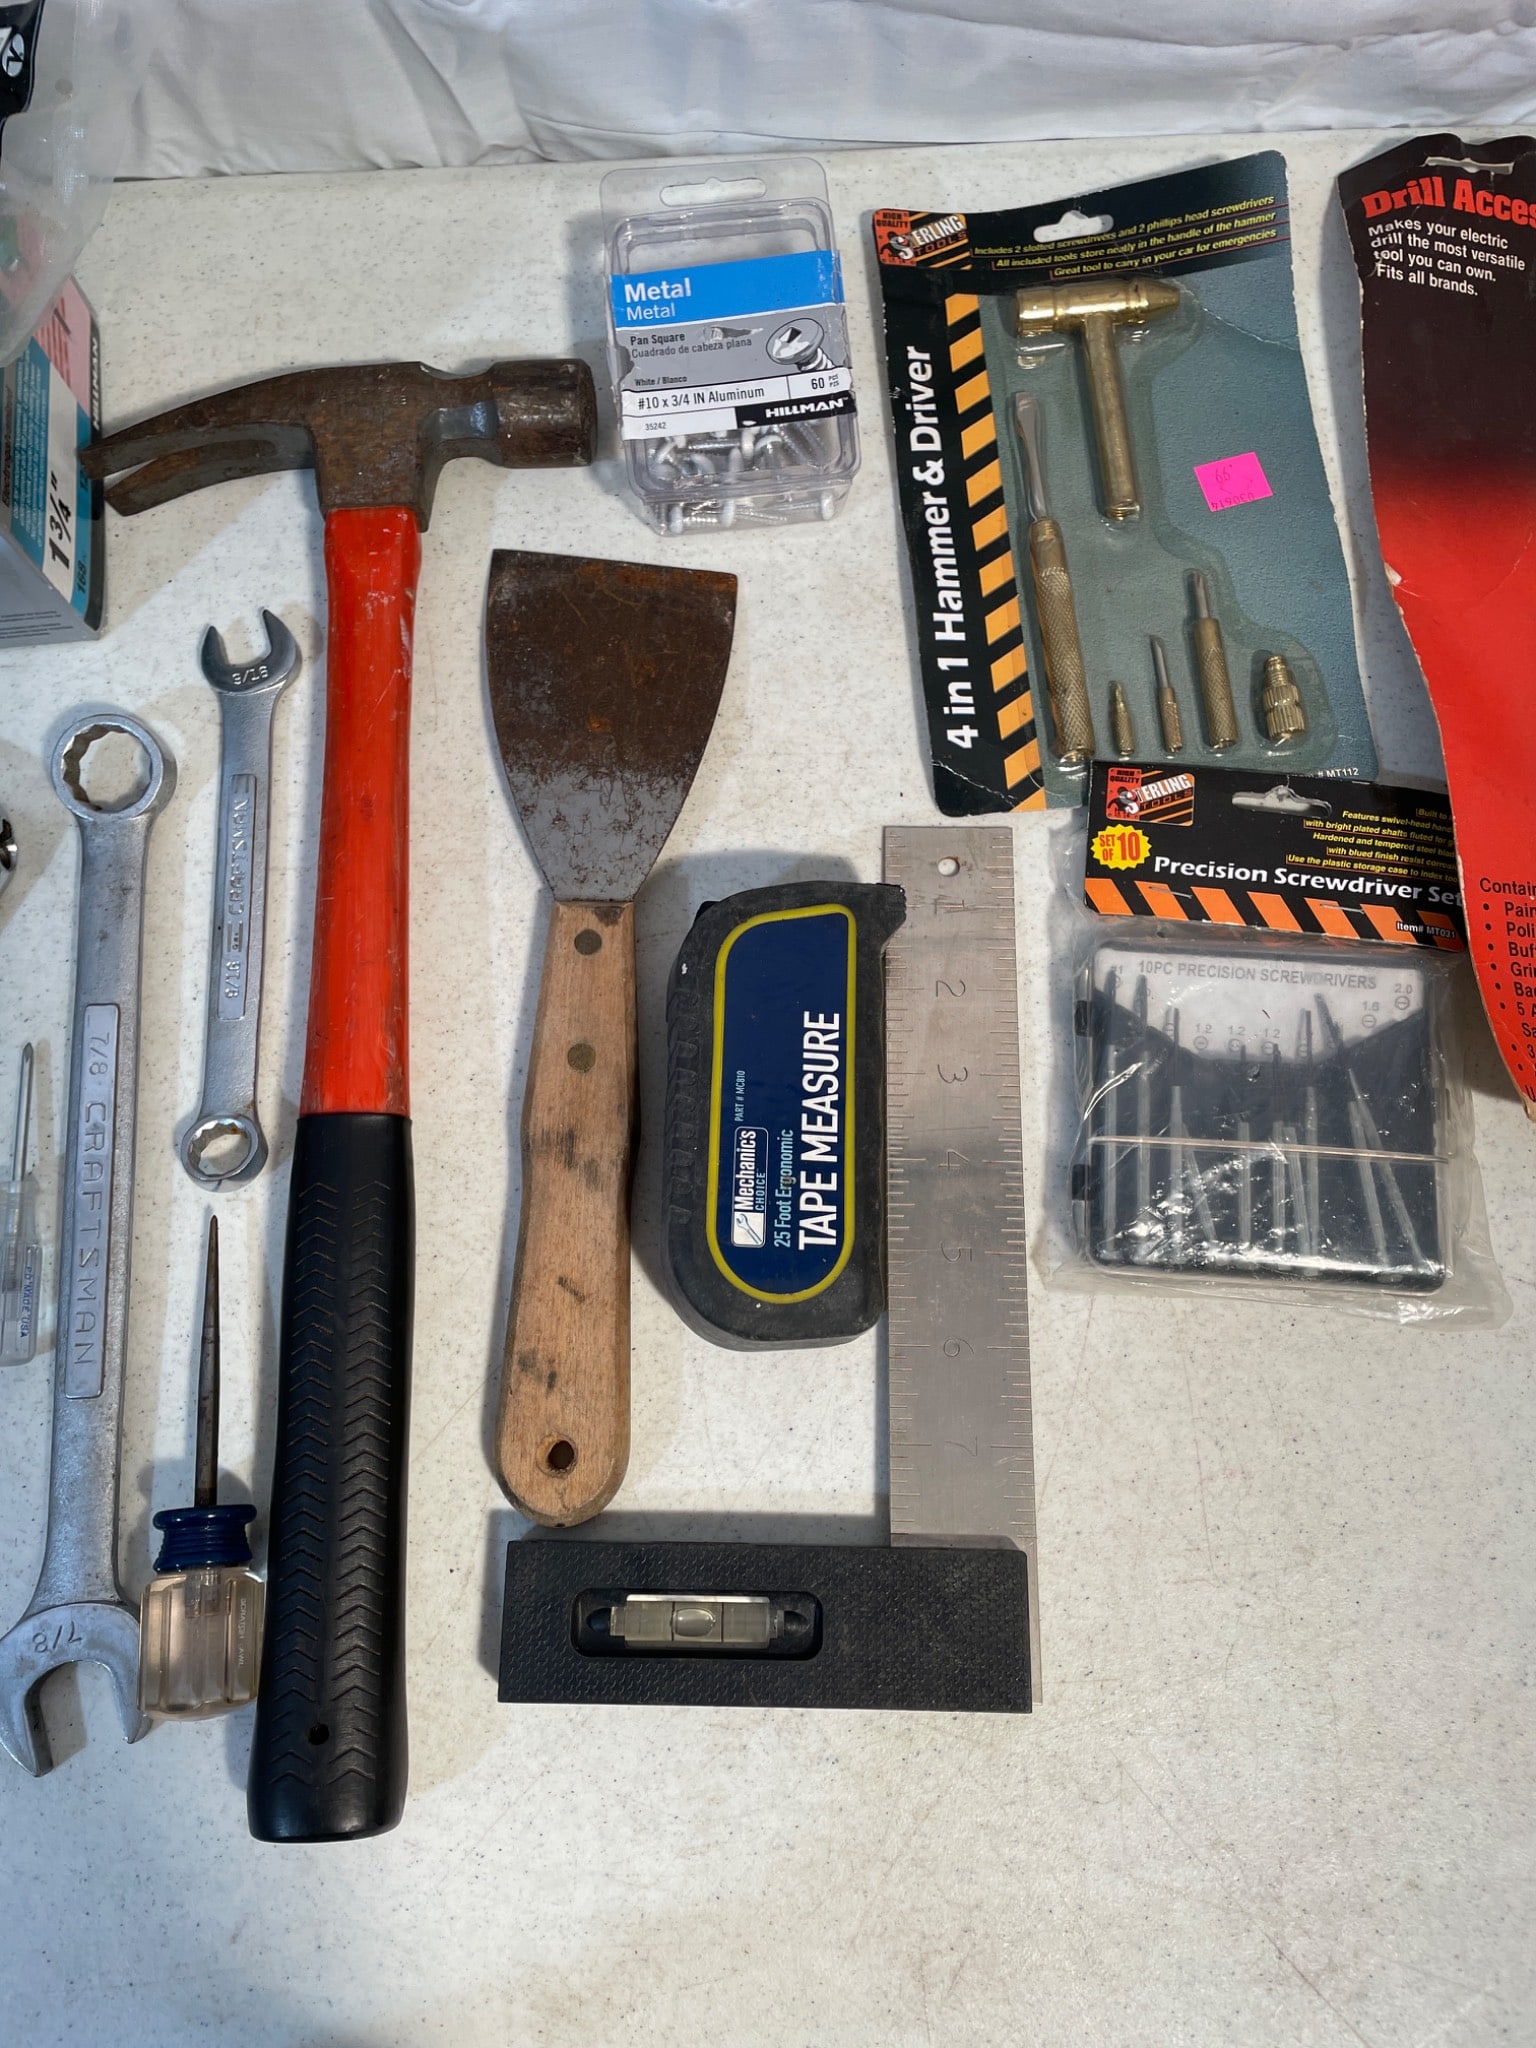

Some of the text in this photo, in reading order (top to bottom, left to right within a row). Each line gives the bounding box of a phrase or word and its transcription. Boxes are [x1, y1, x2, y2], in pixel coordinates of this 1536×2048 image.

[1361, 176, 1446, 218] Drill
[876, 219, 908, 228] QUALITY
[974, 246, 1013, 255] Includes
[1022, 242, 1055, 253] slotted
[1118, 226, 1137, 237] and
[1138, 223, 1145, 232] 2
[1146, 216, 1183, 233] phillips
[1184, 209, 1209, 223] head
[1211, 195, 1275, 216] screwdrivers
[1368, 218, 1509, 249] Makes your electric
[912, 231, 967, 256] TOOLS
[996, 212, 1276, 267] All included tools store neatly in the handle of the hammer
[1370, 232, 1526, 270] drill the most versatile
[1054, 228, 1277, 276] Great tool to carry in your car for emergencies
[1373, 249, 1497, 282] tool you can own.
[624, 278, 692, 303] Metal
[1376, 264, 1478, 296] Fits all brands.
[626, 303, 676, 321] Metal
[630, 332, 685, 346] Pan Square
[632, 338, 752, 359] Cuadrado de cabeza plana
[635, 375, 688, 387] White Blanco
[811, 379, 825, 390] 60
[638, 386, 765, 410] #10 x 3/4 IN Aluminum
[765, 398, 844, 418] HILLMAN
[645, 422, 667, 431] 35242
[49, 538, 69, 569] 1
[905, 345, 978, 749] 4 in 1 Hammer & Driver
[1109, 776, 1139, 784] QUALITY
[1326, 767, 1360, 778] MT112
[1141, 789, 1192, 810] TOOLS
[1306, 819, 1324, 828] with
[1325, 820, 1351, 832] bright
[1353, 825, 1380, 836] plated
[1381, 828, 1407, 838] shafts
[1409, 831, 1434, 842] fluted
[1342, 811, 1431, 829] Features swivel-head
[1099, 834, 1116, 847] SET
[1102, 831, 1141, 862] OF 10
[1313, 832, 1437, 855] Hardened and tempered steel
[228, 799, 249, 916] CRAFTSMAN
[1288, 854, 1443, 881] Use the plastic storage case to index
[1328, 847, 1425, 865] with blued finish resist
[1154, 855, 1462, 906] Precision Screwdriver Set
[1396, 921, 1457, 939] Item# MT031
[1138, 960, 1377, 990] 10PC PRECISION SCREWDRIVERS
[936, 980, 966, 997] 2
[1394, 983, 1413, 995] 2.0
[1517, 1001, 1526, 1016] 5
[937, 1064, 968, 1084] 3
[734, 1070, 746, 1122] PART MC810
[798, 1010, 840, 1250] TAPE MEASURE
[734, 1130, 757, 1211] Mechanic's
[938, 1148, 970, 1172] 4
[73, 1031, 110, 1365] 7/8 CRAFTSMAN
[755, 1172, 766, 1211] CHOICE
[774, 1129, 797, 1248] 25 Foot Ergonomic
[940, 1242, 973, 1263] 5
[943, 1337, 975, 1358] 6
[32, 1621, 82, 1653] 7/8
